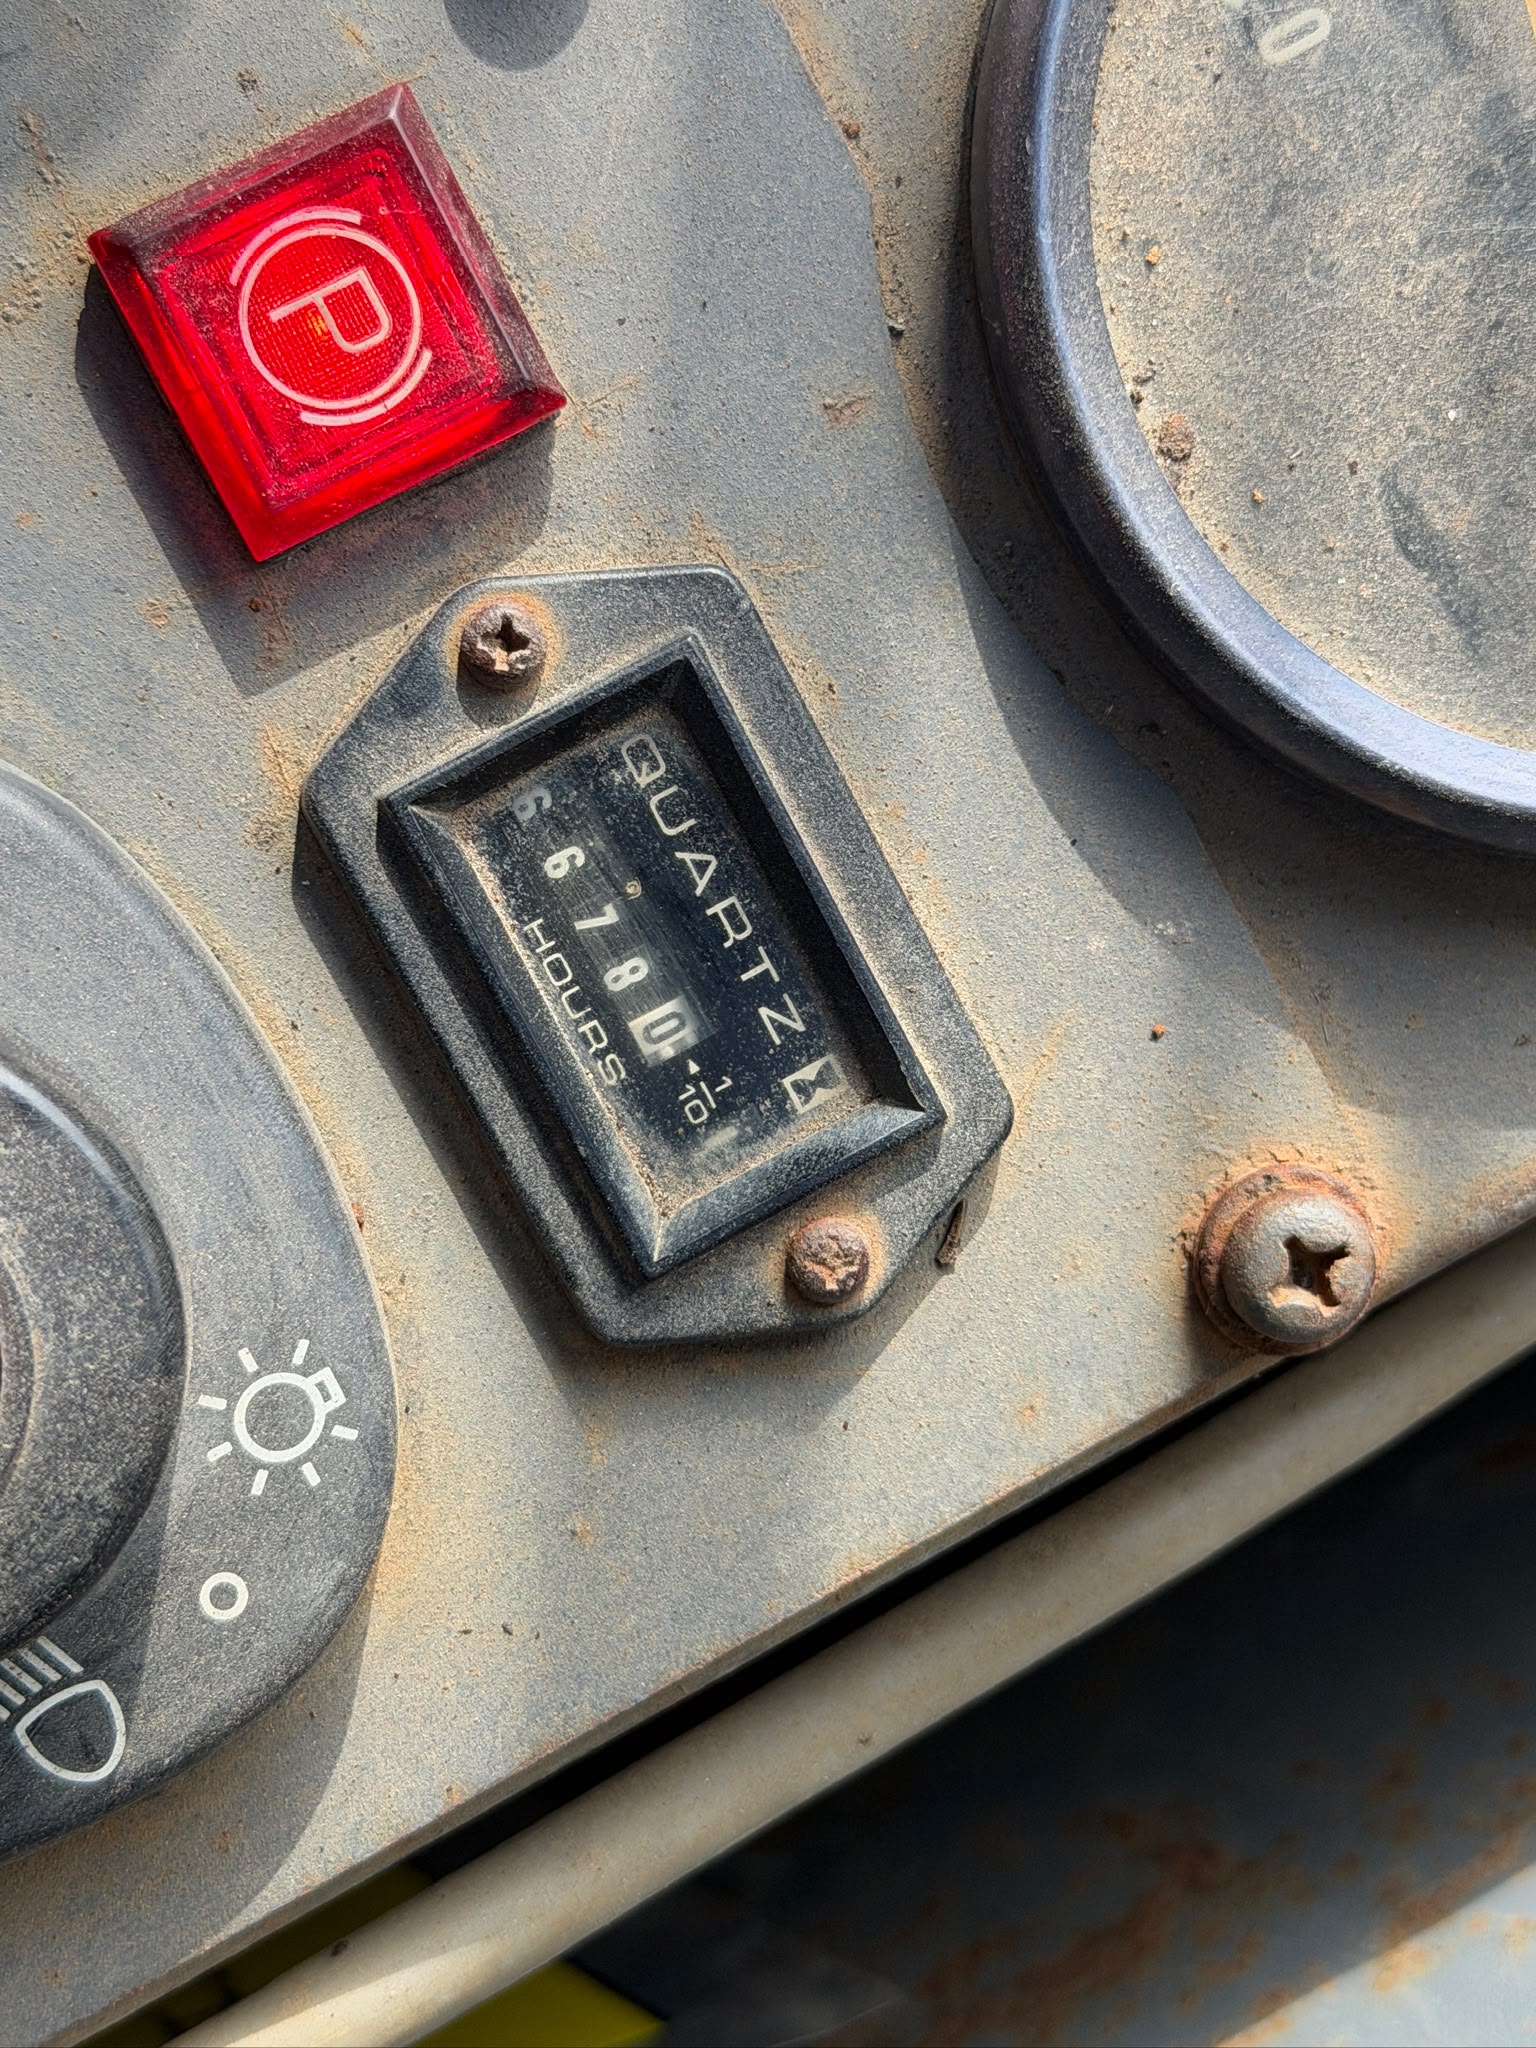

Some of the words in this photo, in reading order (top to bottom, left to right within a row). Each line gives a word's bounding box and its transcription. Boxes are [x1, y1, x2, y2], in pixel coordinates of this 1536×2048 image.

[268, 266, 393, 353] P
[621, 734, 806, 1046] QUARTZ
[523, 918, 627, 1087] HOURS
